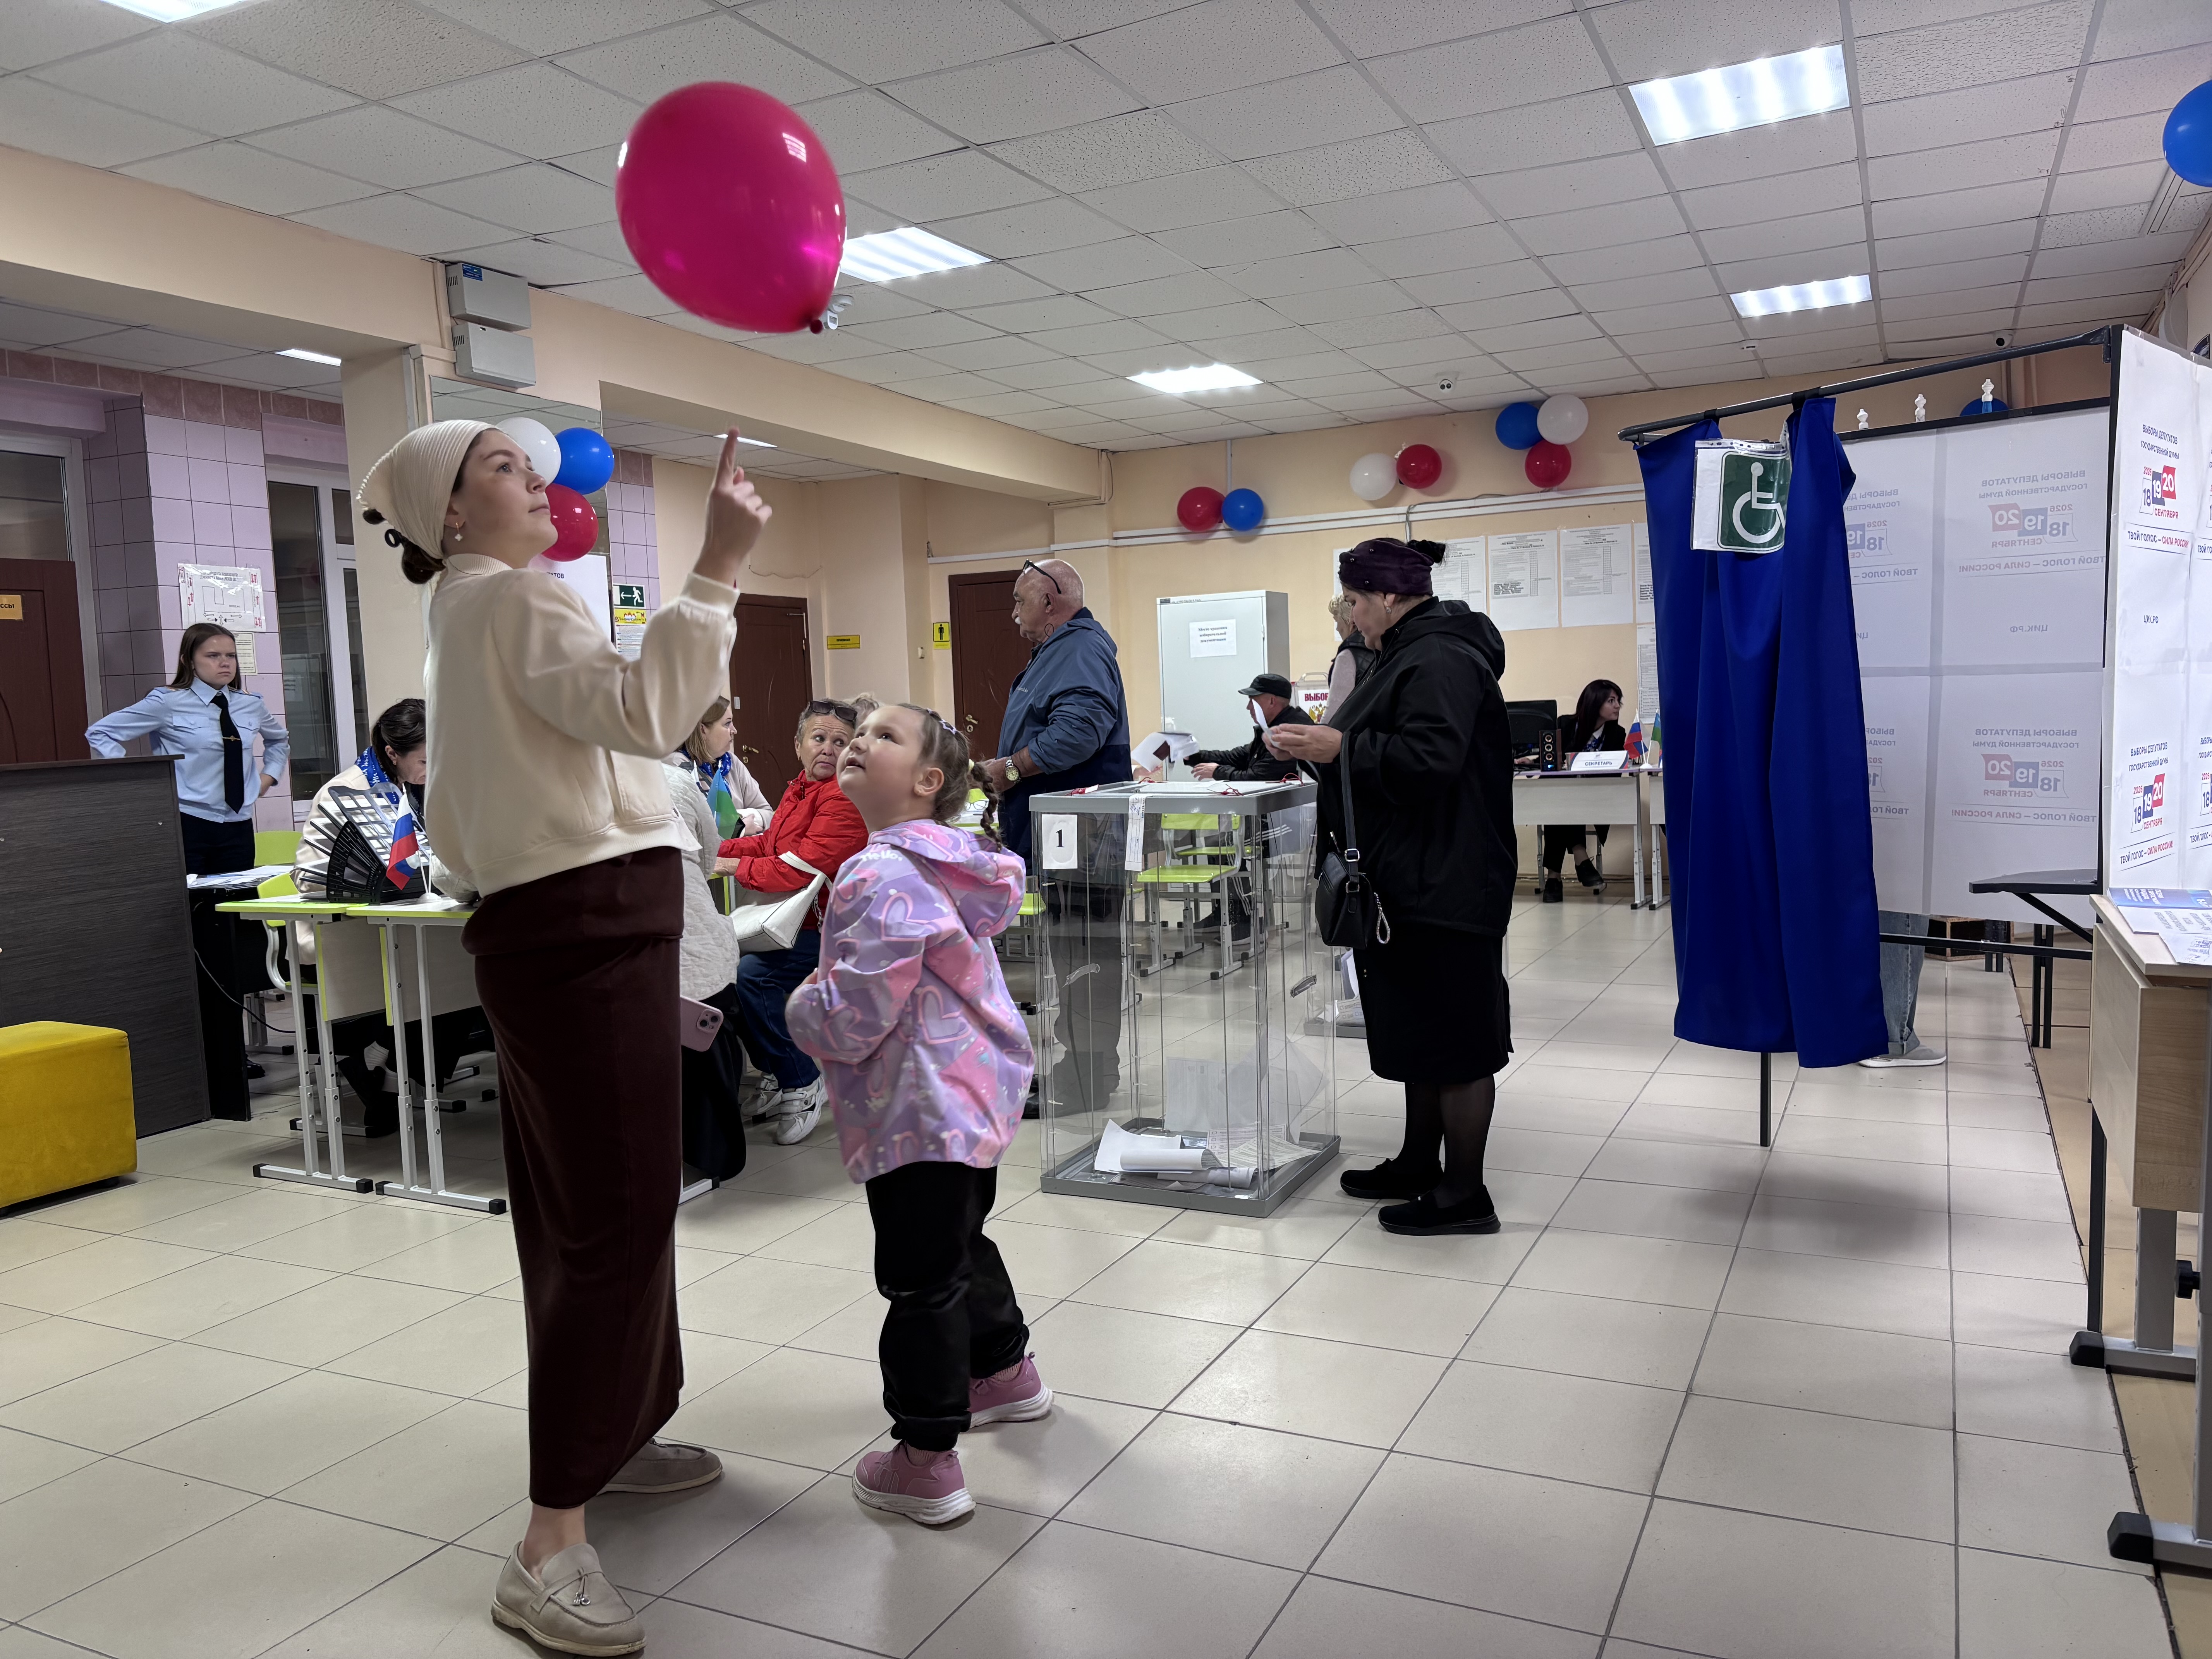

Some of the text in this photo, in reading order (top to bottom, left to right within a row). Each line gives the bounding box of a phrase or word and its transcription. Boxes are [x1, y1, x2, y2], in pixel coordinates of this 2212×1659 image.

[2142, 424, 2158, 439] ВЫБОРЫ
[2143, 466, 2152, 476] 2026
[2143, 473, 2174, 507] 18 19 20
[2154, 508, 2179, 519] СЕНТЯБРЯ
[2128, 531, 2140, 541] ТВОЙ
[2141, 533, 2157, 543] ГОЛОС
[2162, 536, 2173, 545] СИЛА
[2131, 742, 2167, 757] ВЫБОРЫ ДЕПУТАТОВ
[2133, 786, 2143, 795] 2026
[2134, 781, 2162, 824] 18 19 20
[2203, 792, 2209, 808] 18
[2144, 817, 2162, 830] СЕНТЯБРЯ
[1055, 829, 1065, 848] 1
[2120, 852, 2130, 864] ТВОЙ
[2131, 850, 2143, 861] ГОЛОС
[2147, 844, 2157, 855] СИЛА
